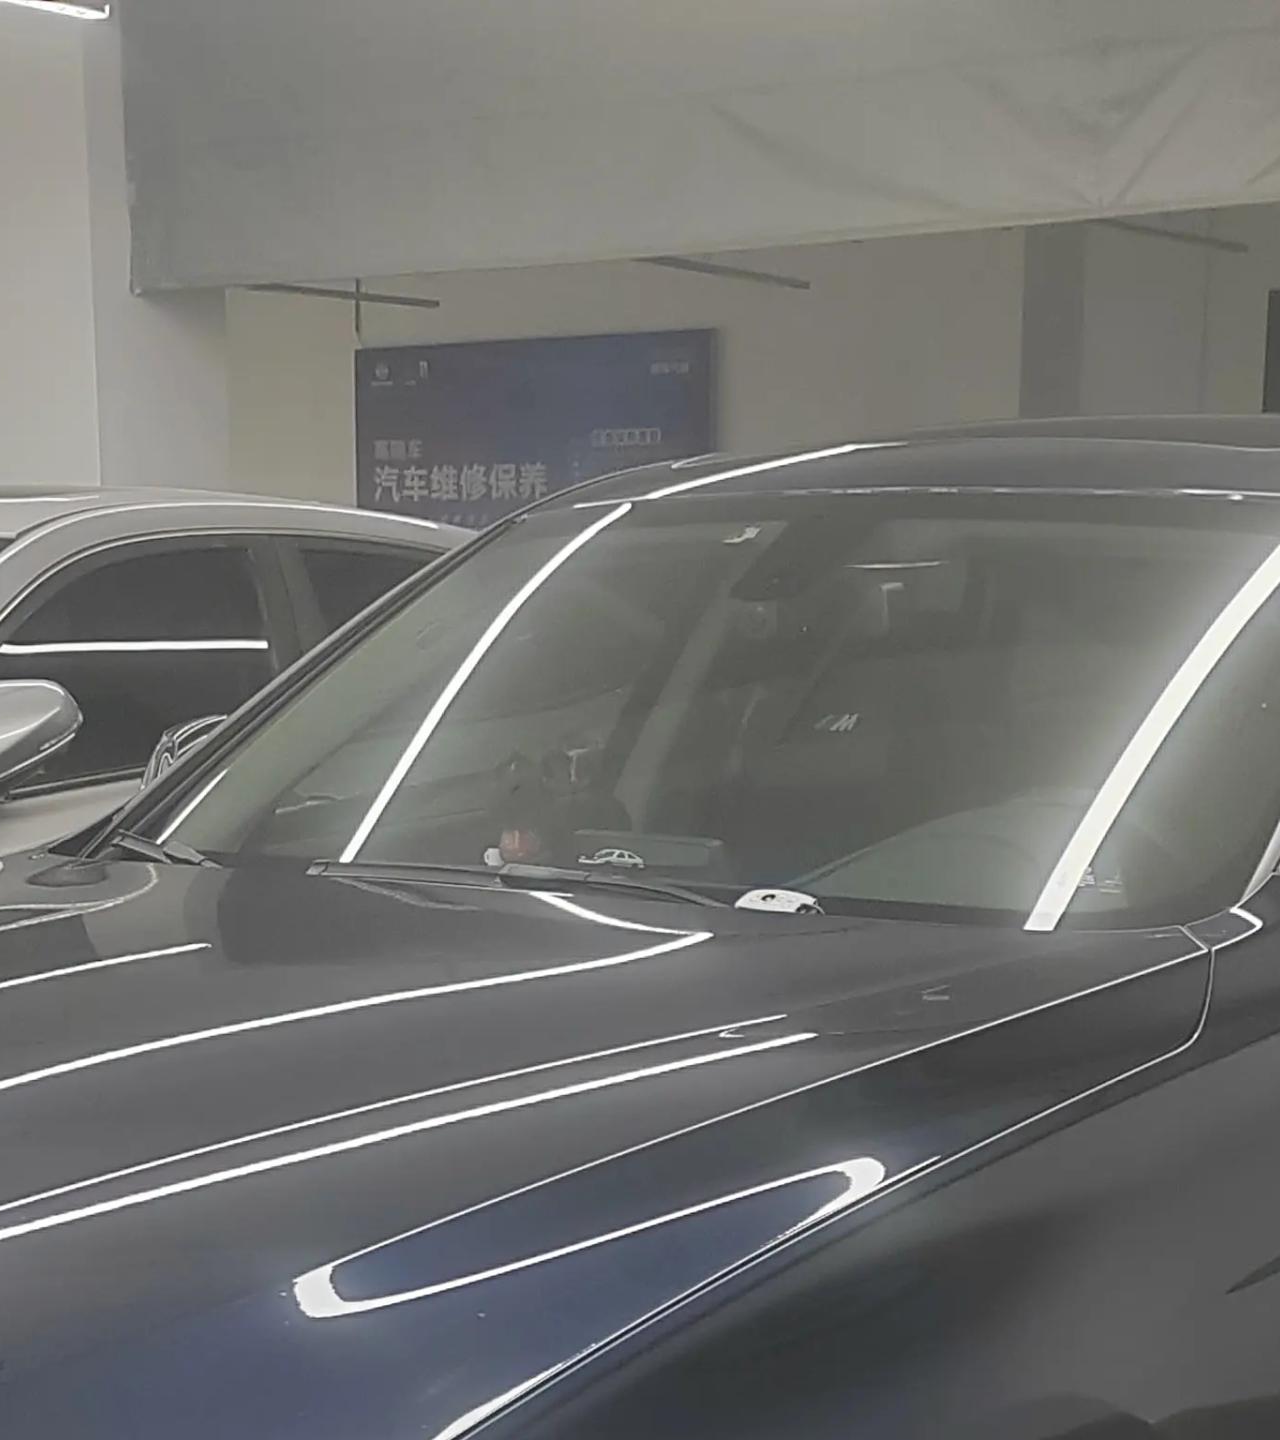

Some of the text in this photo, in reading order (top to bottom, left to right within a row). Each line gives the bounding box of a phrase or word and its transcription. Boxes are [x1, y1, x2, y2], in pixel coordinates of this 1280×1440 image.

[374, 464, 548, 502] 汽车维修保养
